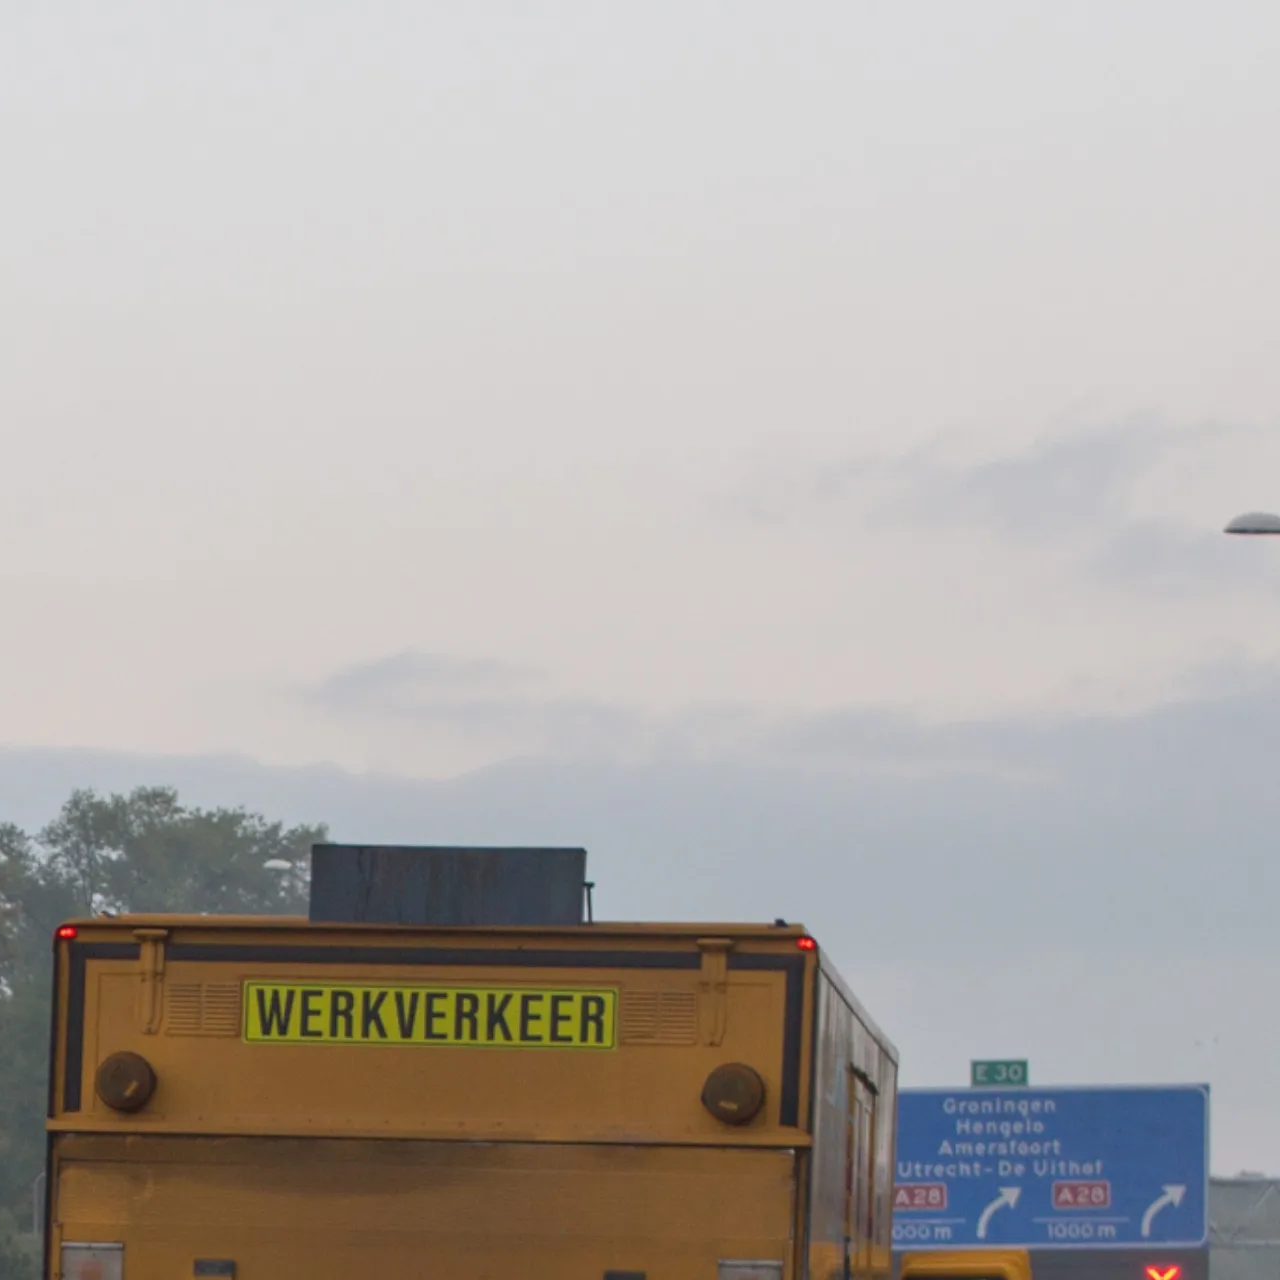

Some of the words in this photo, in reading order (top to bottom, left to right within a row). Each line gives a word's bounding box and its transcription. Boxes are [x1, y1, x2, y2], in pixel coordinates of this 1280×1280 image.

[255, 987, 606, 1044] WERKVERKEER
[975, 1065, 989, 1081] E
[995, 1064, 1023, 1081] 30
[942, 1097, 1056, 1117] Groningen
[956, 1118, 1045, 1138] Hengelo
[938, 1139, 1061, 1157] Amersfoort
[1033, 1158, 1104, 1176] Uithof
[895, 1187, 942, 1205] A28
[1057, 1186, 1105, 1204] A28
[892, 1225, 930, 1240] 000
[934, 1226, 951, 1240] m
[1047, 1223, 1093, 1239] 1000
[1097, 1225, 1116, 1239] m
